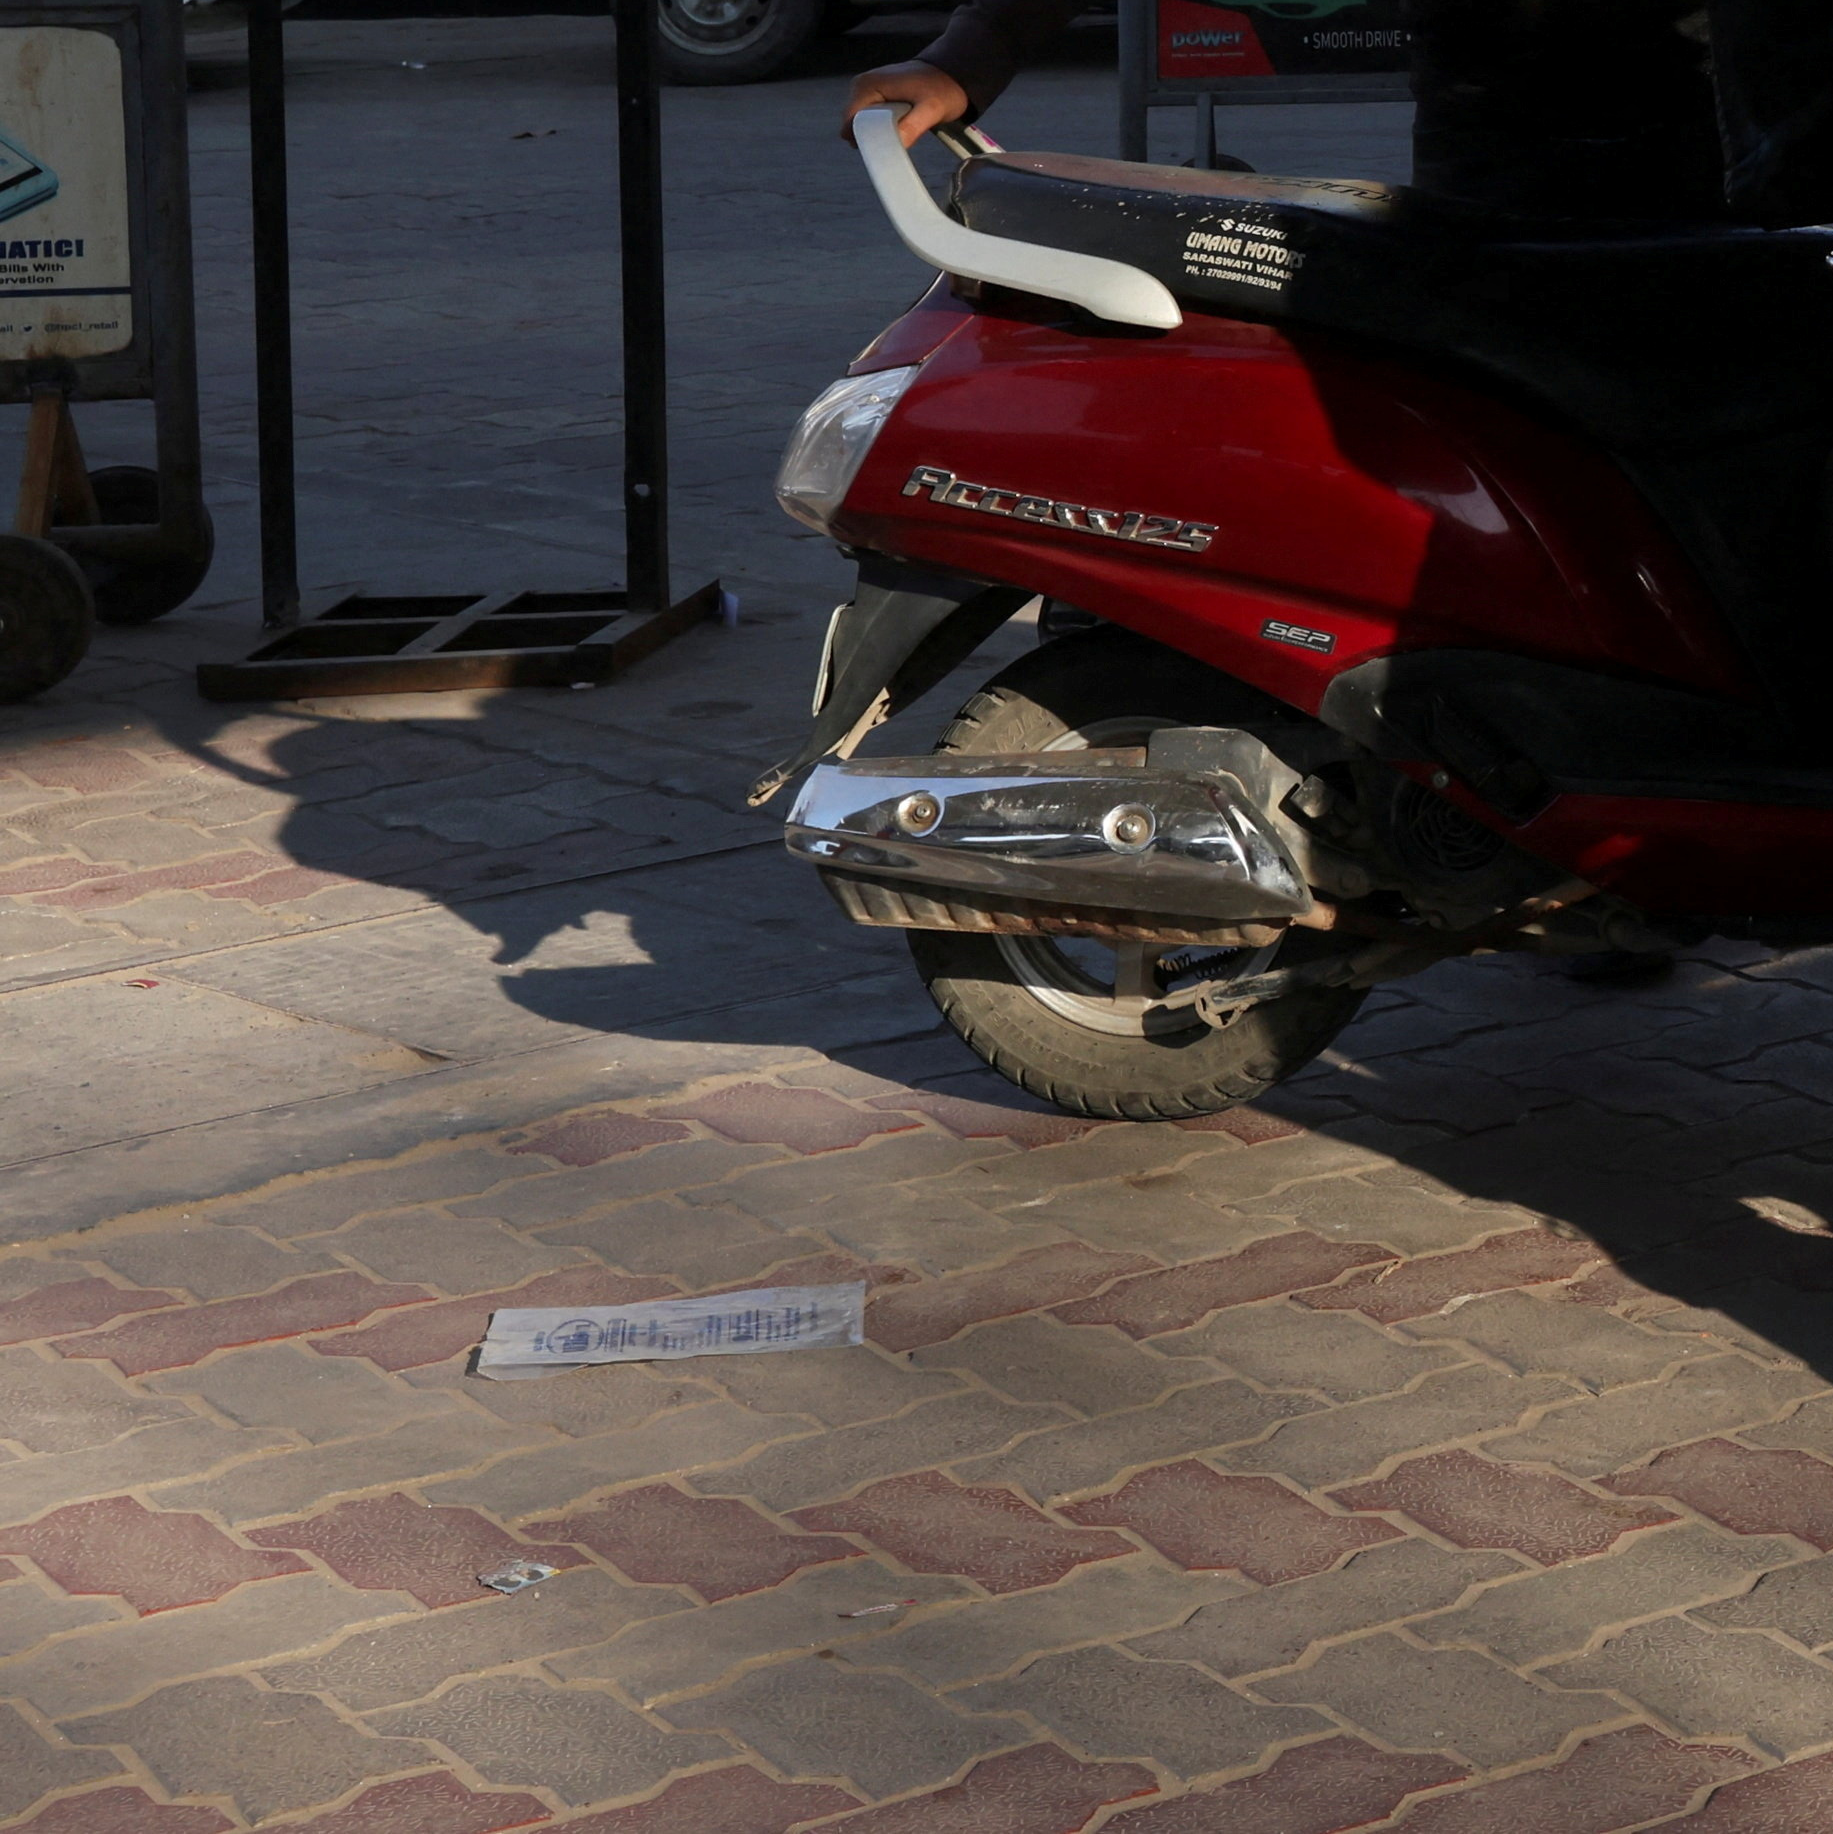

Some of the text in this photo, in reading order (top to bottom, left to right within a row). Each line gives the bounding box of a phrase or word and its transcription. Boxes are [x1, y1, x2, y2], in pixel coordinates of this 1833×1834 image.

[1312, 30, 1402, 50] SMOOTH DRIVE
[1235, 222, 1288, 241] SUZUKI
[1186, 231, 1306, 268] UMANG MOTORS
[32, 263, 65, 273] With
[1182, 251, 1294, 281] SARASWATI VIHAR
[1265, 621, 1331, 643] SEP
